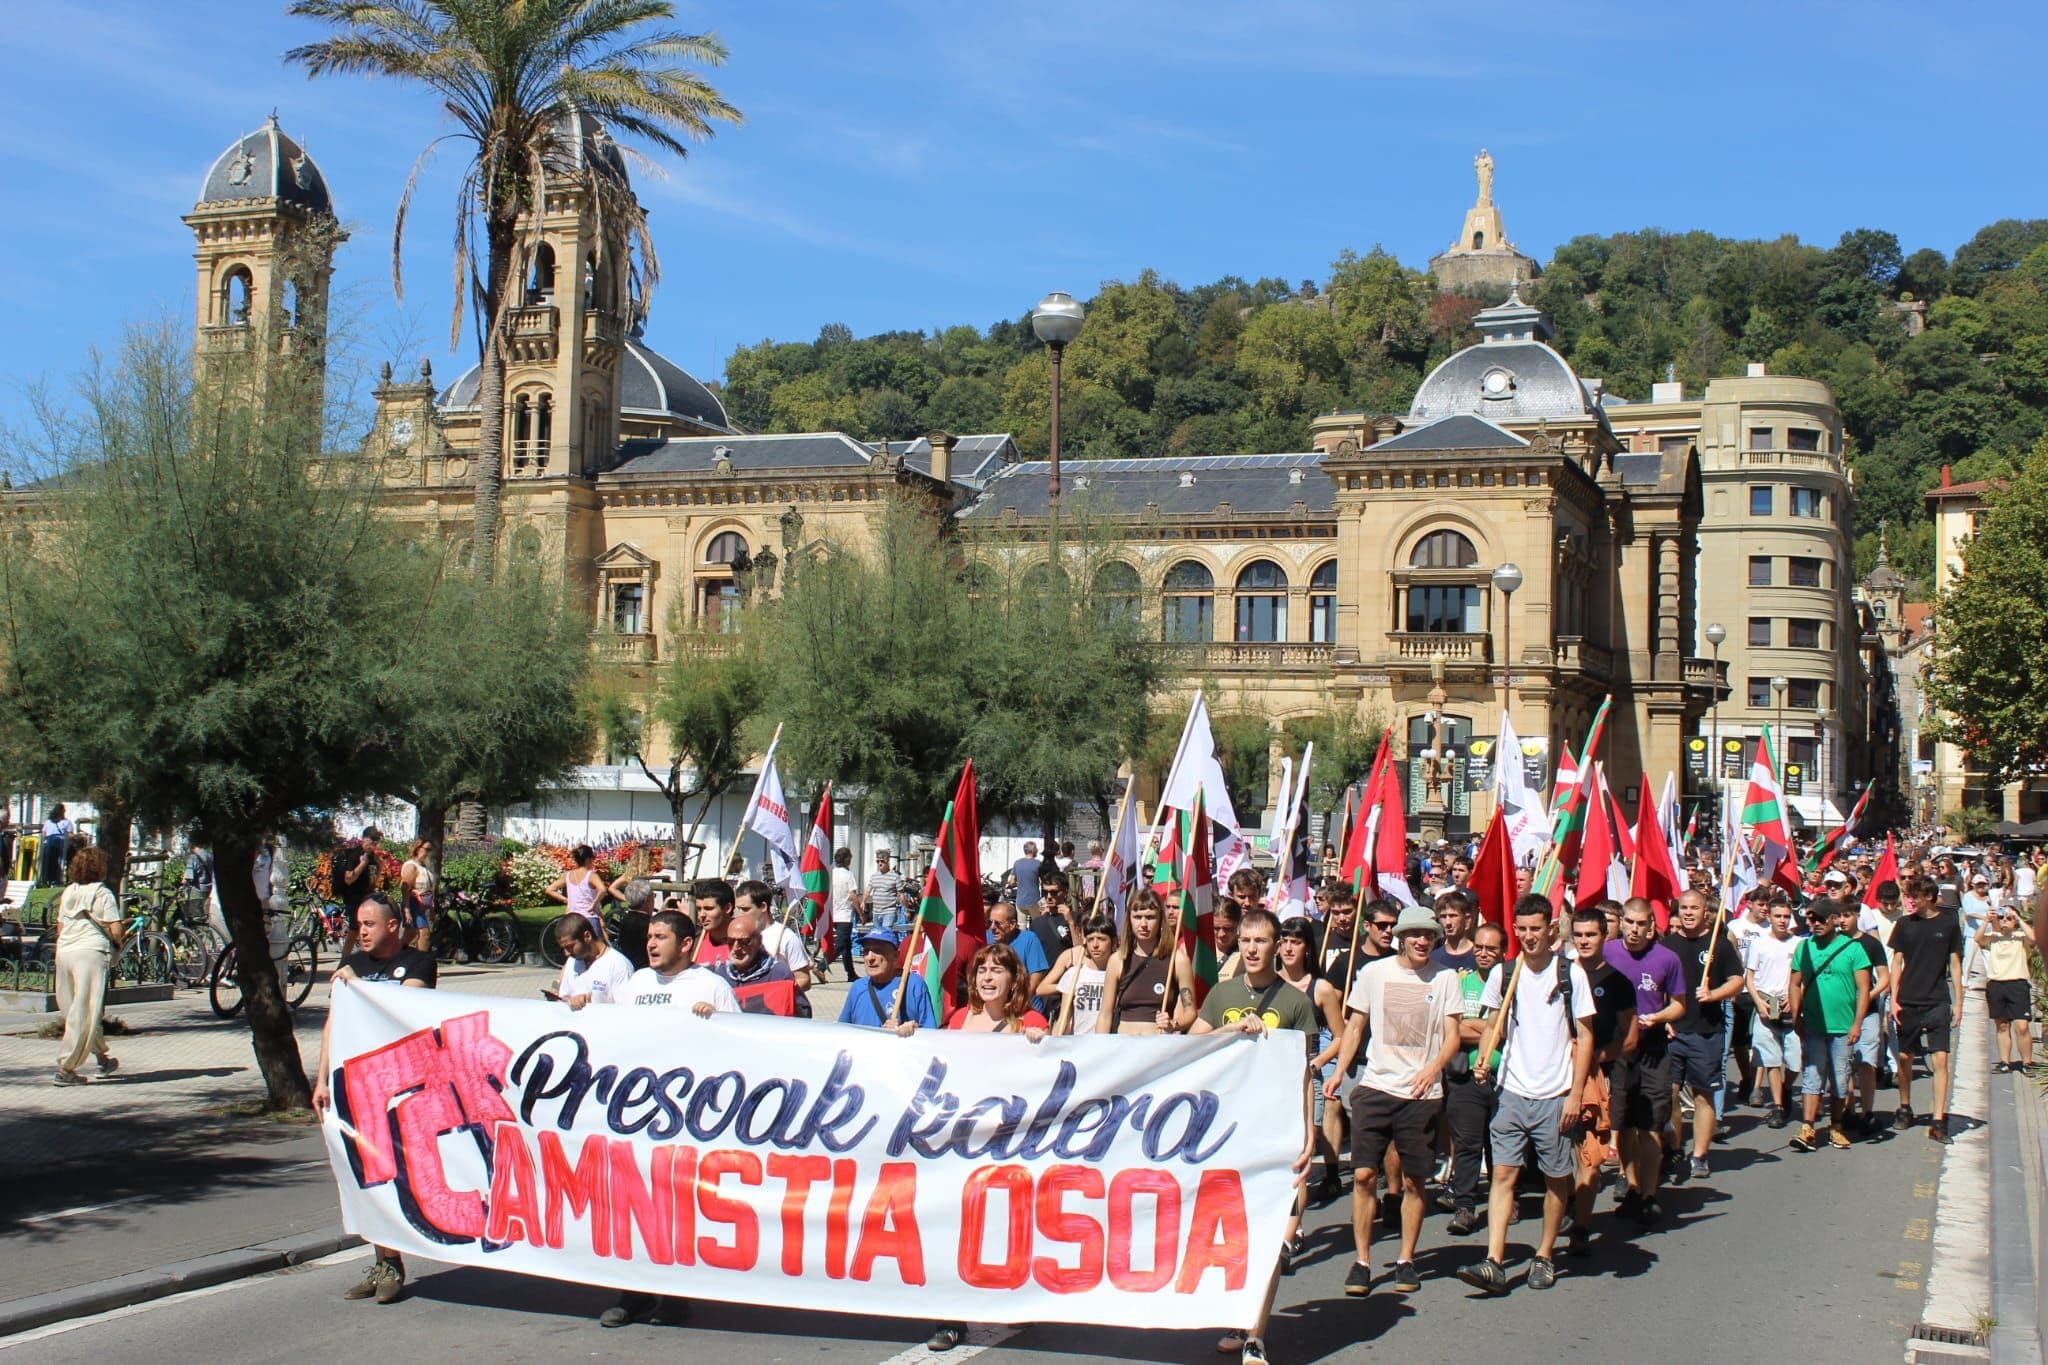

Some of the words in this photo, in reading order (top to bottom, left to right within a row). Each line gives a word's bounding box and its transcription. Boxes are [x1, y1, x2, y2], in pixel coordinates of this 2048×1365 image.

[511, 1030, 880, 1153] Presoak
[887, 1056, 1238, 1164] kalera
[487, 1121, 926, 1287] AMNISTIA
[958, 1164, 1249, 1296] OSOA
